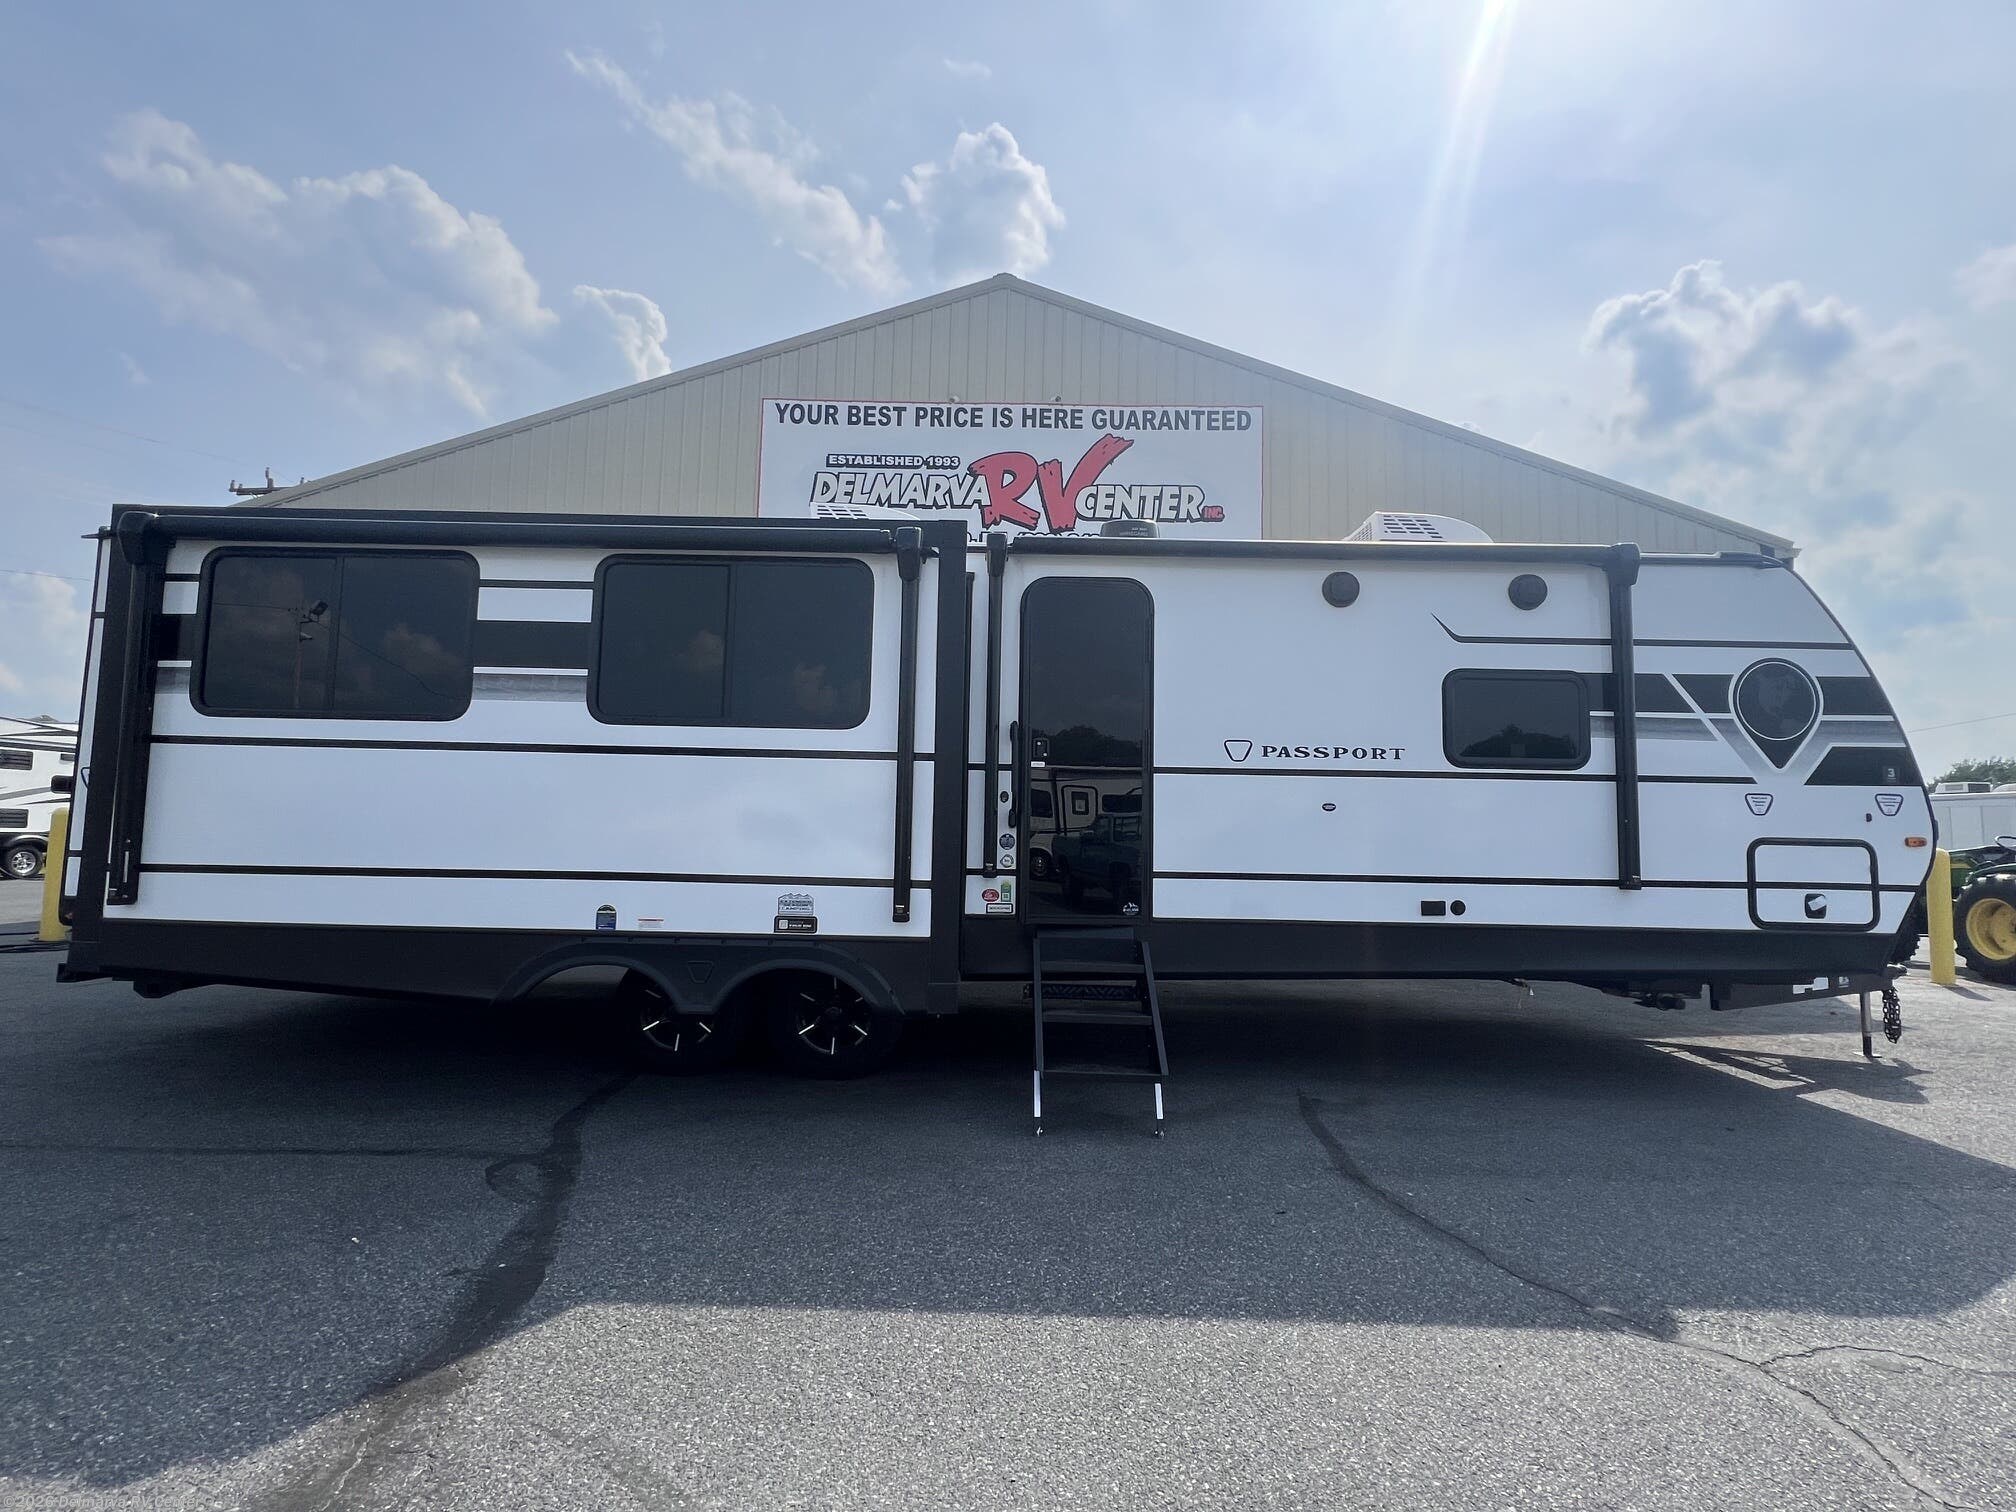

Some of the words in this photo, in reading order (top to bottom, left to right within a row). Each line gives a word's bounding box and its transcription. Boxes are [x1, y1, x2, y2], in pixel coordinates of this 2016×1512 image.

[775, 402, 839, 425] YOUR
[848, 405, 907, 427] BEST
[914, 406, 984, 428] PRICE
[992, 407, 1014, 428] IS
[1022, 408, 1084, 430] HERE
[1091, 409, 1252, 431] GUARANTEED
[828, 454, 923, 468] ESTABLISHED
[925, 456, 961, 469] 1993
[811, 472, 992, 509] DELMARVA
[967, 433, 1135, 534] RV
[1075, 484, 1206, 522] CENTER
[1261, 745, 1406, 760] PASSPORT
